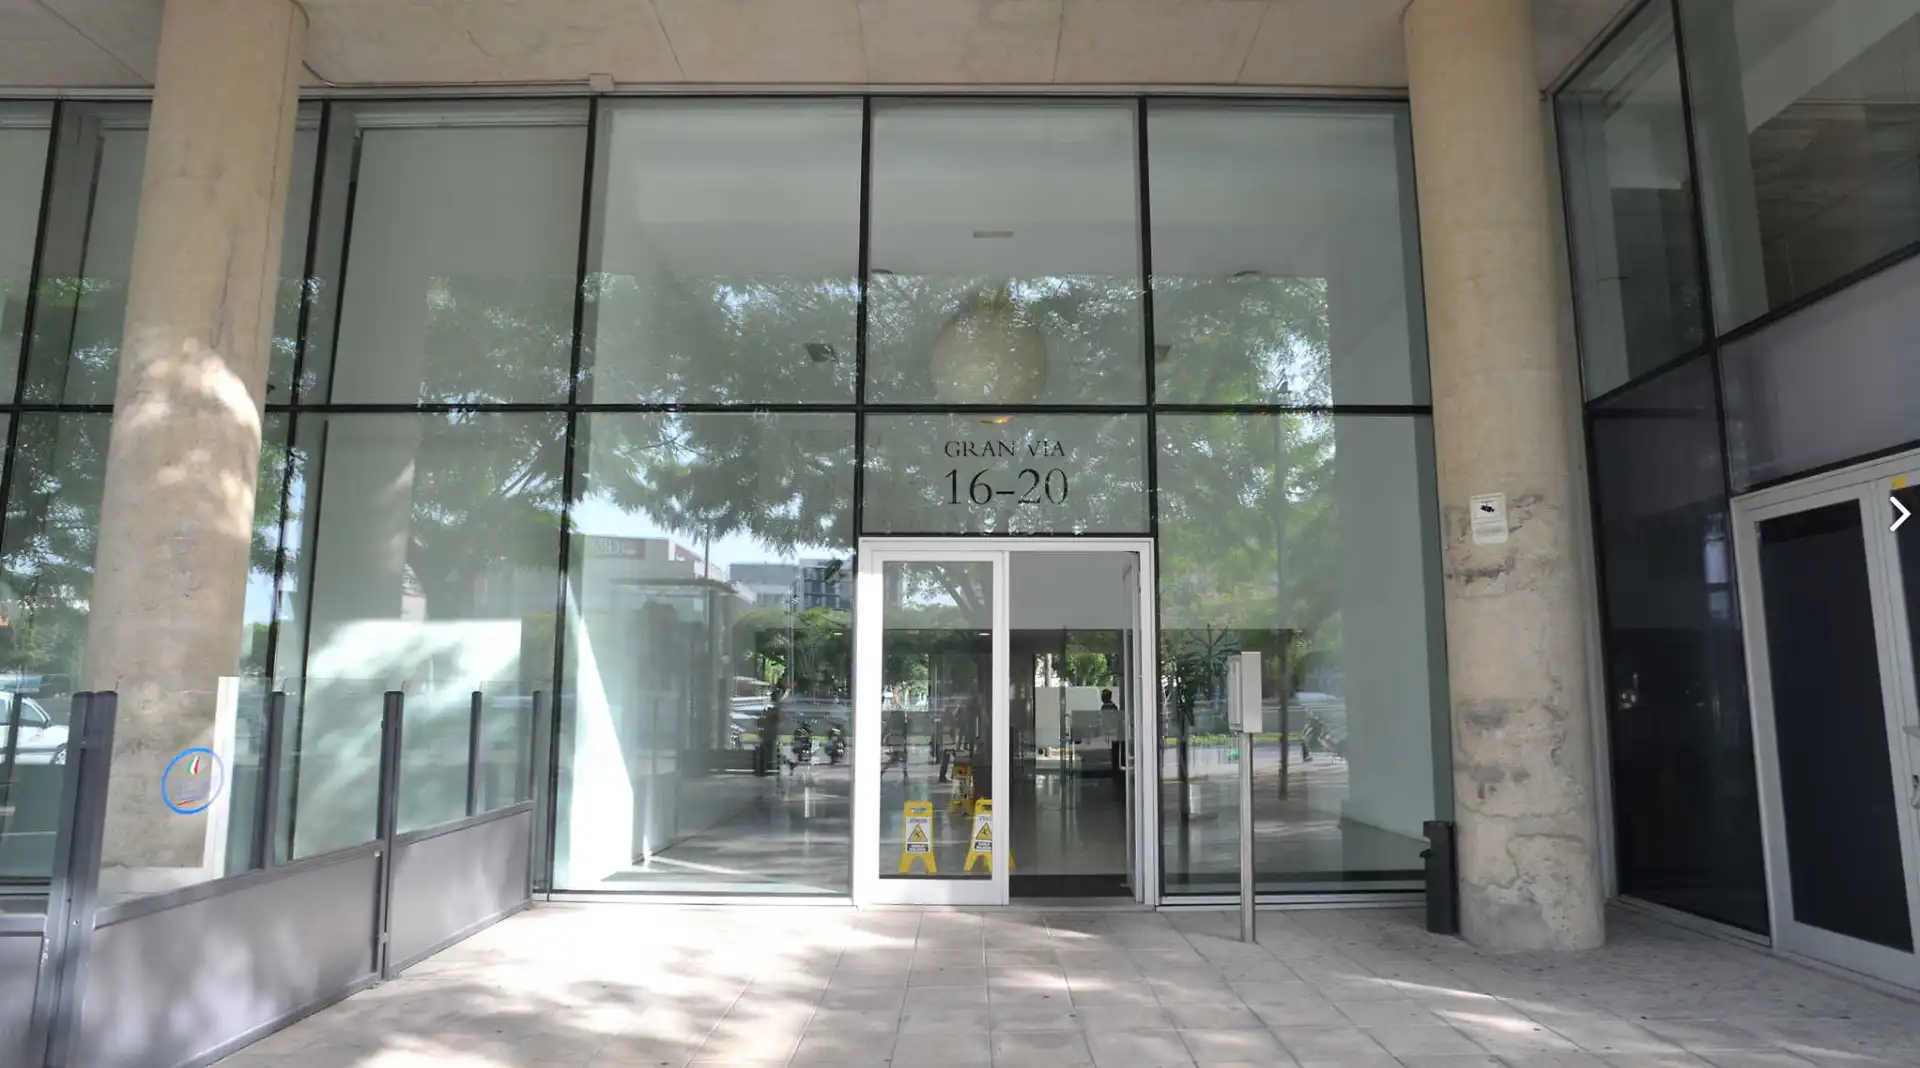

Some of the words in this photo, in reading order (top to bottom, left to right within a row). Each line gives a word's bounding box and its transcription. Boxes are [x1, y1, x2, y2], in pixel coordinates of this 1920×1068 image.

[944, 440, 1015, 458] GRAN
[1027, 440, 1066, 457] VIA
[945, 468, 1069, 505] 16-20
